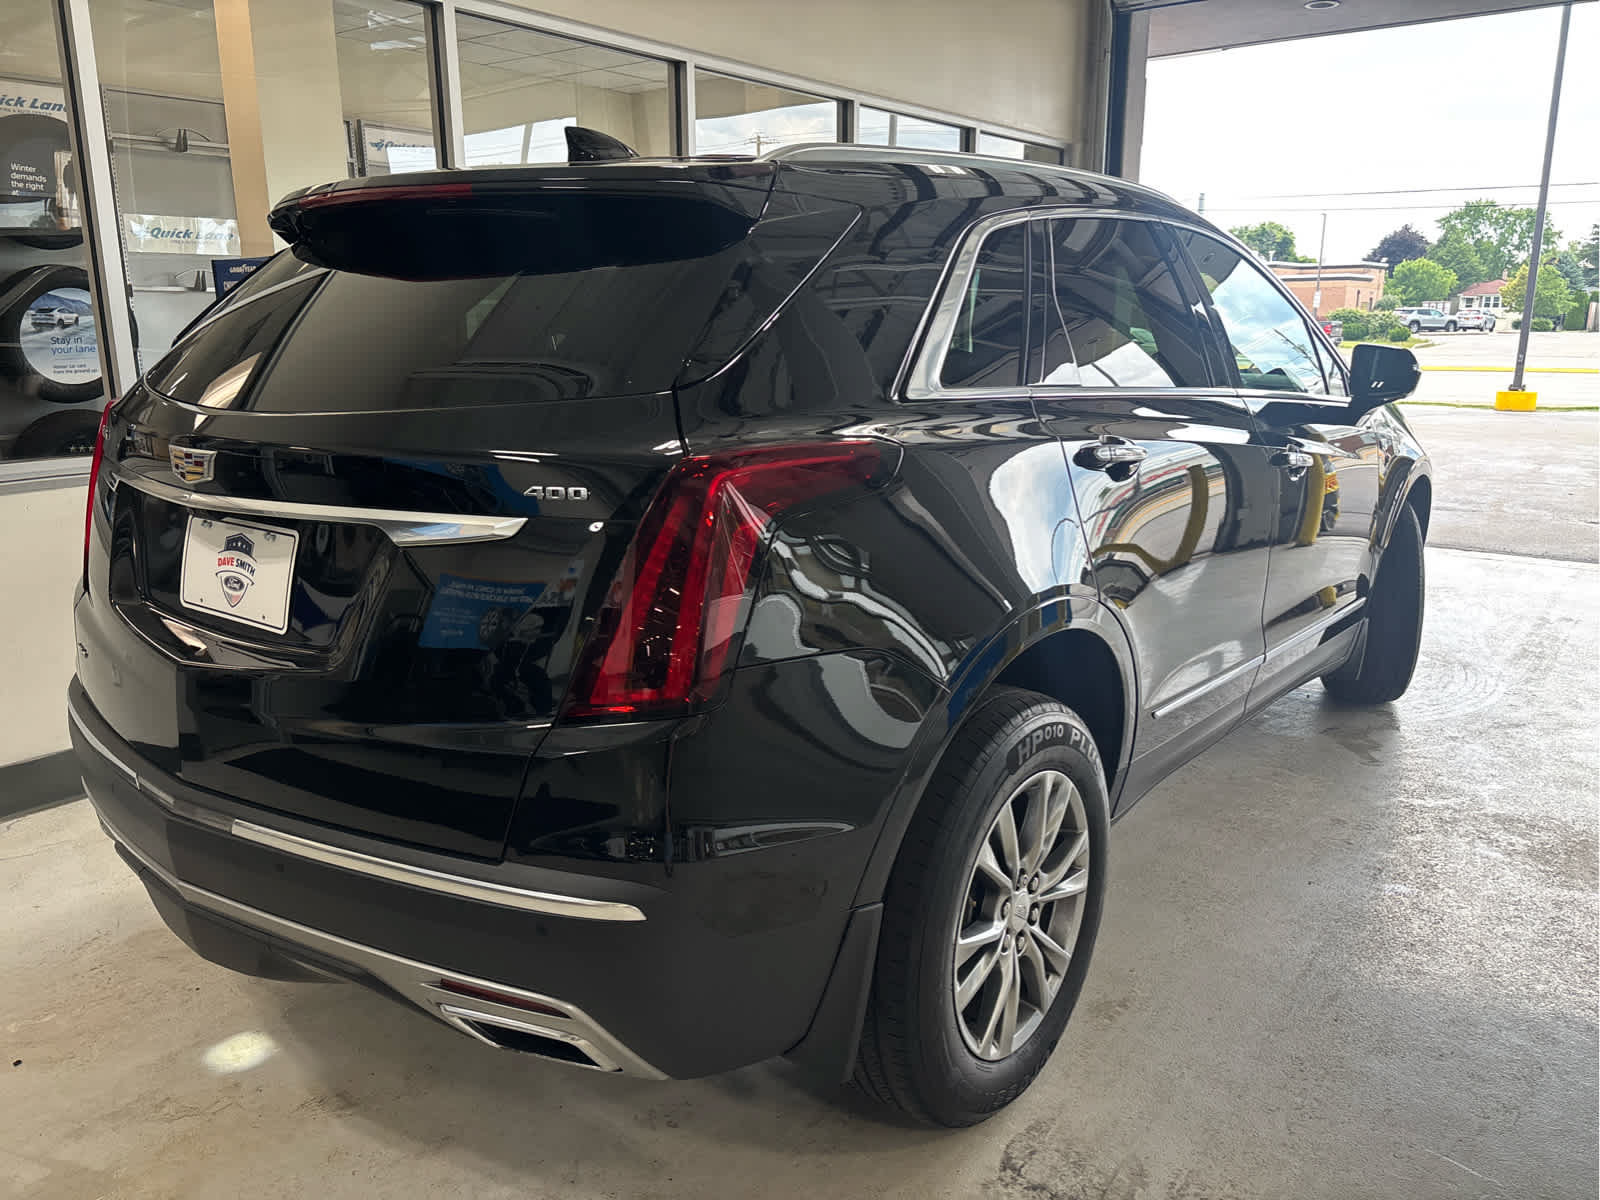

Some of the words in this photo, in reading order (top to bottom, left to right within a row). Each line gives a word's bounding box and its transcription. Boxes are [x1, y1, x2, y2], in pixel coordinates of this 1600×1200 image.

[0, 95, 25, 107] ick
[10, 161, 37, 172] Winter
[10, 172, 47, 183] demands
[11, 180, 24, 188] the
[25, 183, 45, 191] right
[151, 227, 193, 239] Quick
[50, 336, 71, 346] Stay
[73, 336, 83, 344] in
[51, 347, 72, 355] your
[523, 486, 589, 501] 400
[217, 557, 235, 567] DAVE
[235, 558, 256, 577] SMITH
[1018, 724, 1064, 766] HP010
